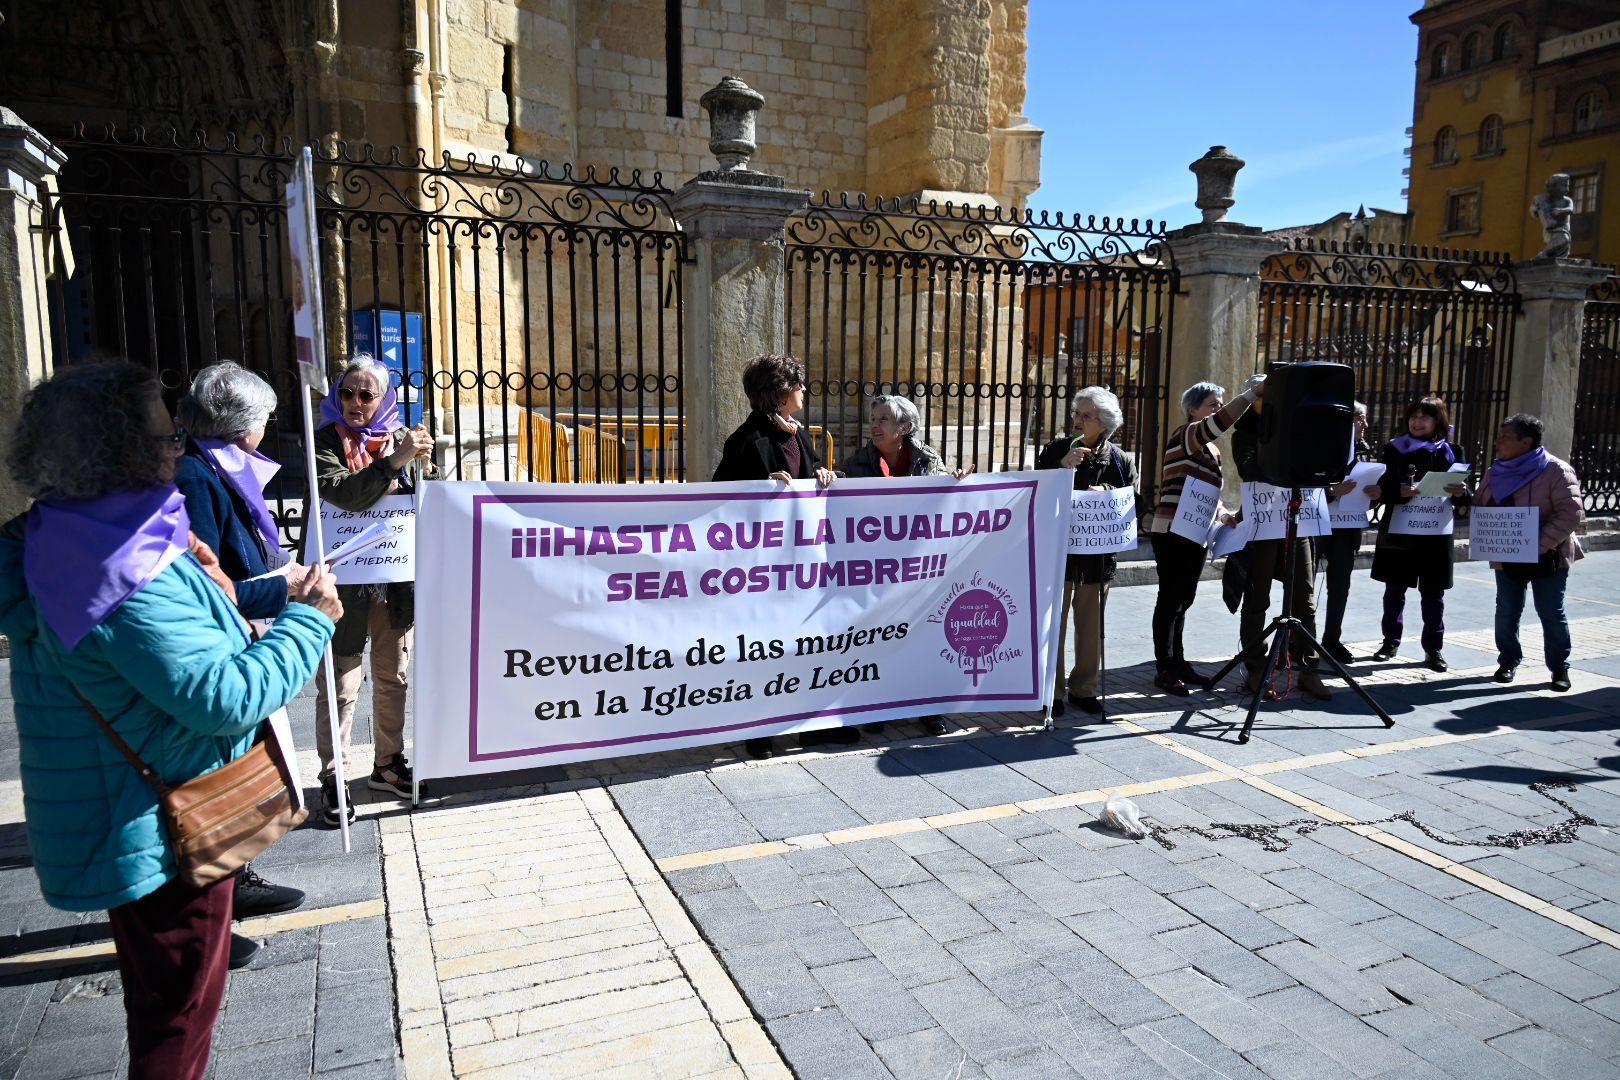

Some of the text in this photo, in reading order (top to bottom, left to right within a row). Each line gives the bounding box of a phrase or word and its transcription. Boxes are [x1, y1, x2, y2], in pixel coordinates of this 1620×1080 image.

[381, 334, 416, 344] turisca
[1253, 489, 1316, 506] SOY MER
[332, 511, 355, 519] LAS
[359, 508, 416, 519] MUJERES
[1077, 510, 1122, 522] SEAMOS
[1183, 511, 1194, 523] EL
[1279, 507, 1322, 522] IESIA
[1330, 514, 1366, 522] EMINIS
[1475, 512, 1526, 521] HASTA QUE SE
[706, 521, 784, 549] QUE
[794, 518, 836, 547] LA
[845, 508, 1012, 543] IGUALDAD
[1070, 521, 1132, 535] OMUNIDAD
[1407, 520, 1439, 529] REVUELTA
[1490, 521, 1508, 529] DEJE
[1510, 521, 1523, 529] DE
[1476, 529, 1523, 537] IDENTIFICAR
[1085, 534, 1131, 547] IGUALES
[1485, 537, 1495, 545] LA
[1495, 538, 1522, 546] CULPA
[1524, 538, 1531, 546] Y
[1487, 546, 1520, 554] PECADO
[354, 554, 409, 566] PIEDRAS
[607, 553, 948, 602] SEA COSTUMBRE!!!
[926, 570, 1019, 624] Revuelta de mujeres
[950, 610, 1000, 636] igualdad
[503, 622, 910, 678] Revuelta de las mujeres
[940, 643, 1024, 673] en la Iglesia
[534, 660, 880, 720] en la Iglesia de León
